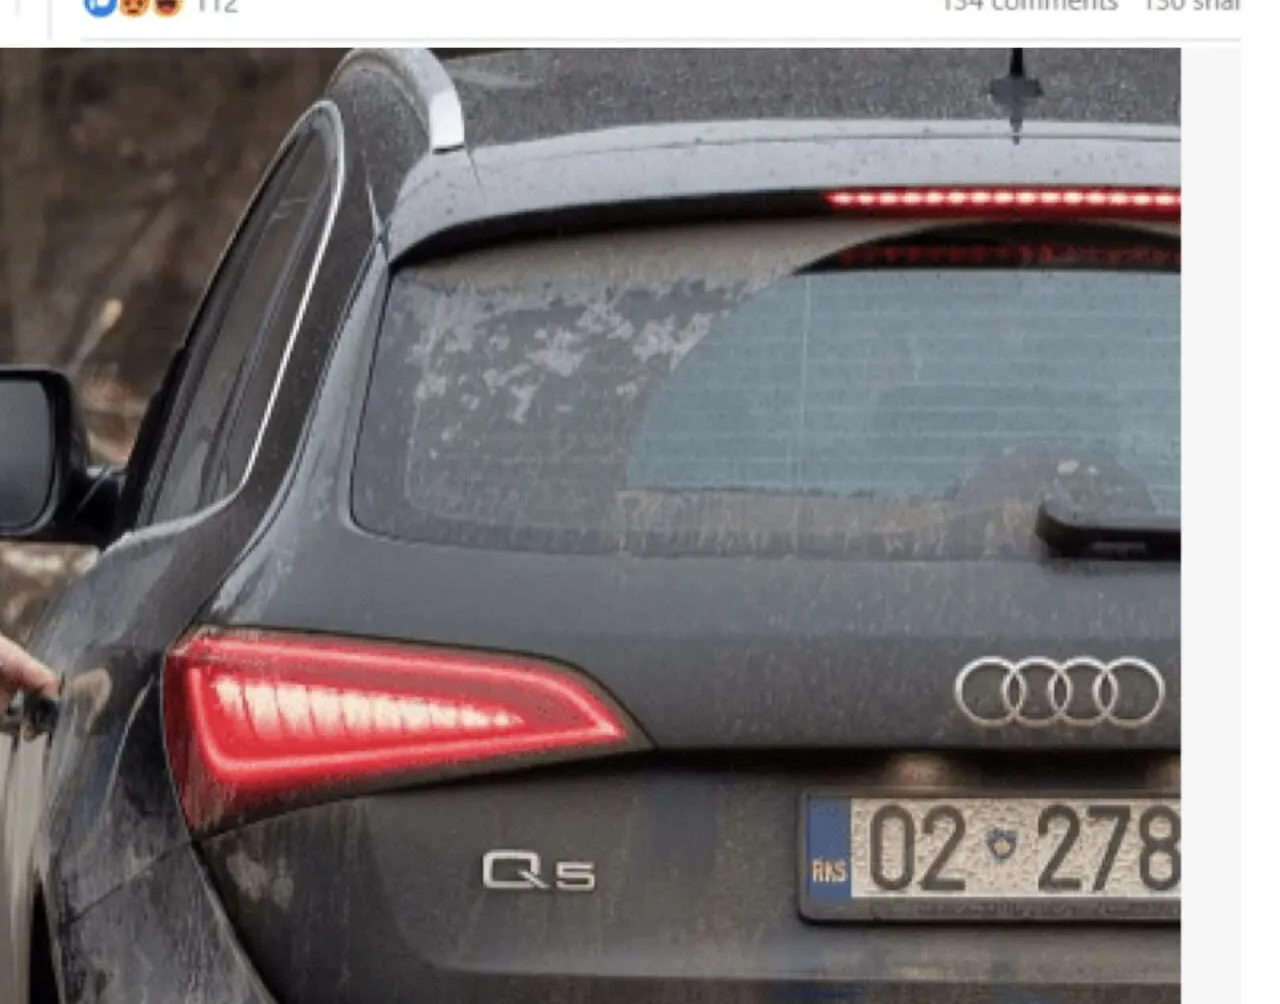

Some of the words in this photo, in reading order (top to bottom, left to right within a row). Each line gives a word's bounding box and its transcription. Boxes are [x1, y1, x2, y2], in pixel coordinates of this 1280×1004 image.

[481, 850, 597, 891] Q5
[870, 804, 966, 891] 02
[1038, 804, 1181, 892] 278
